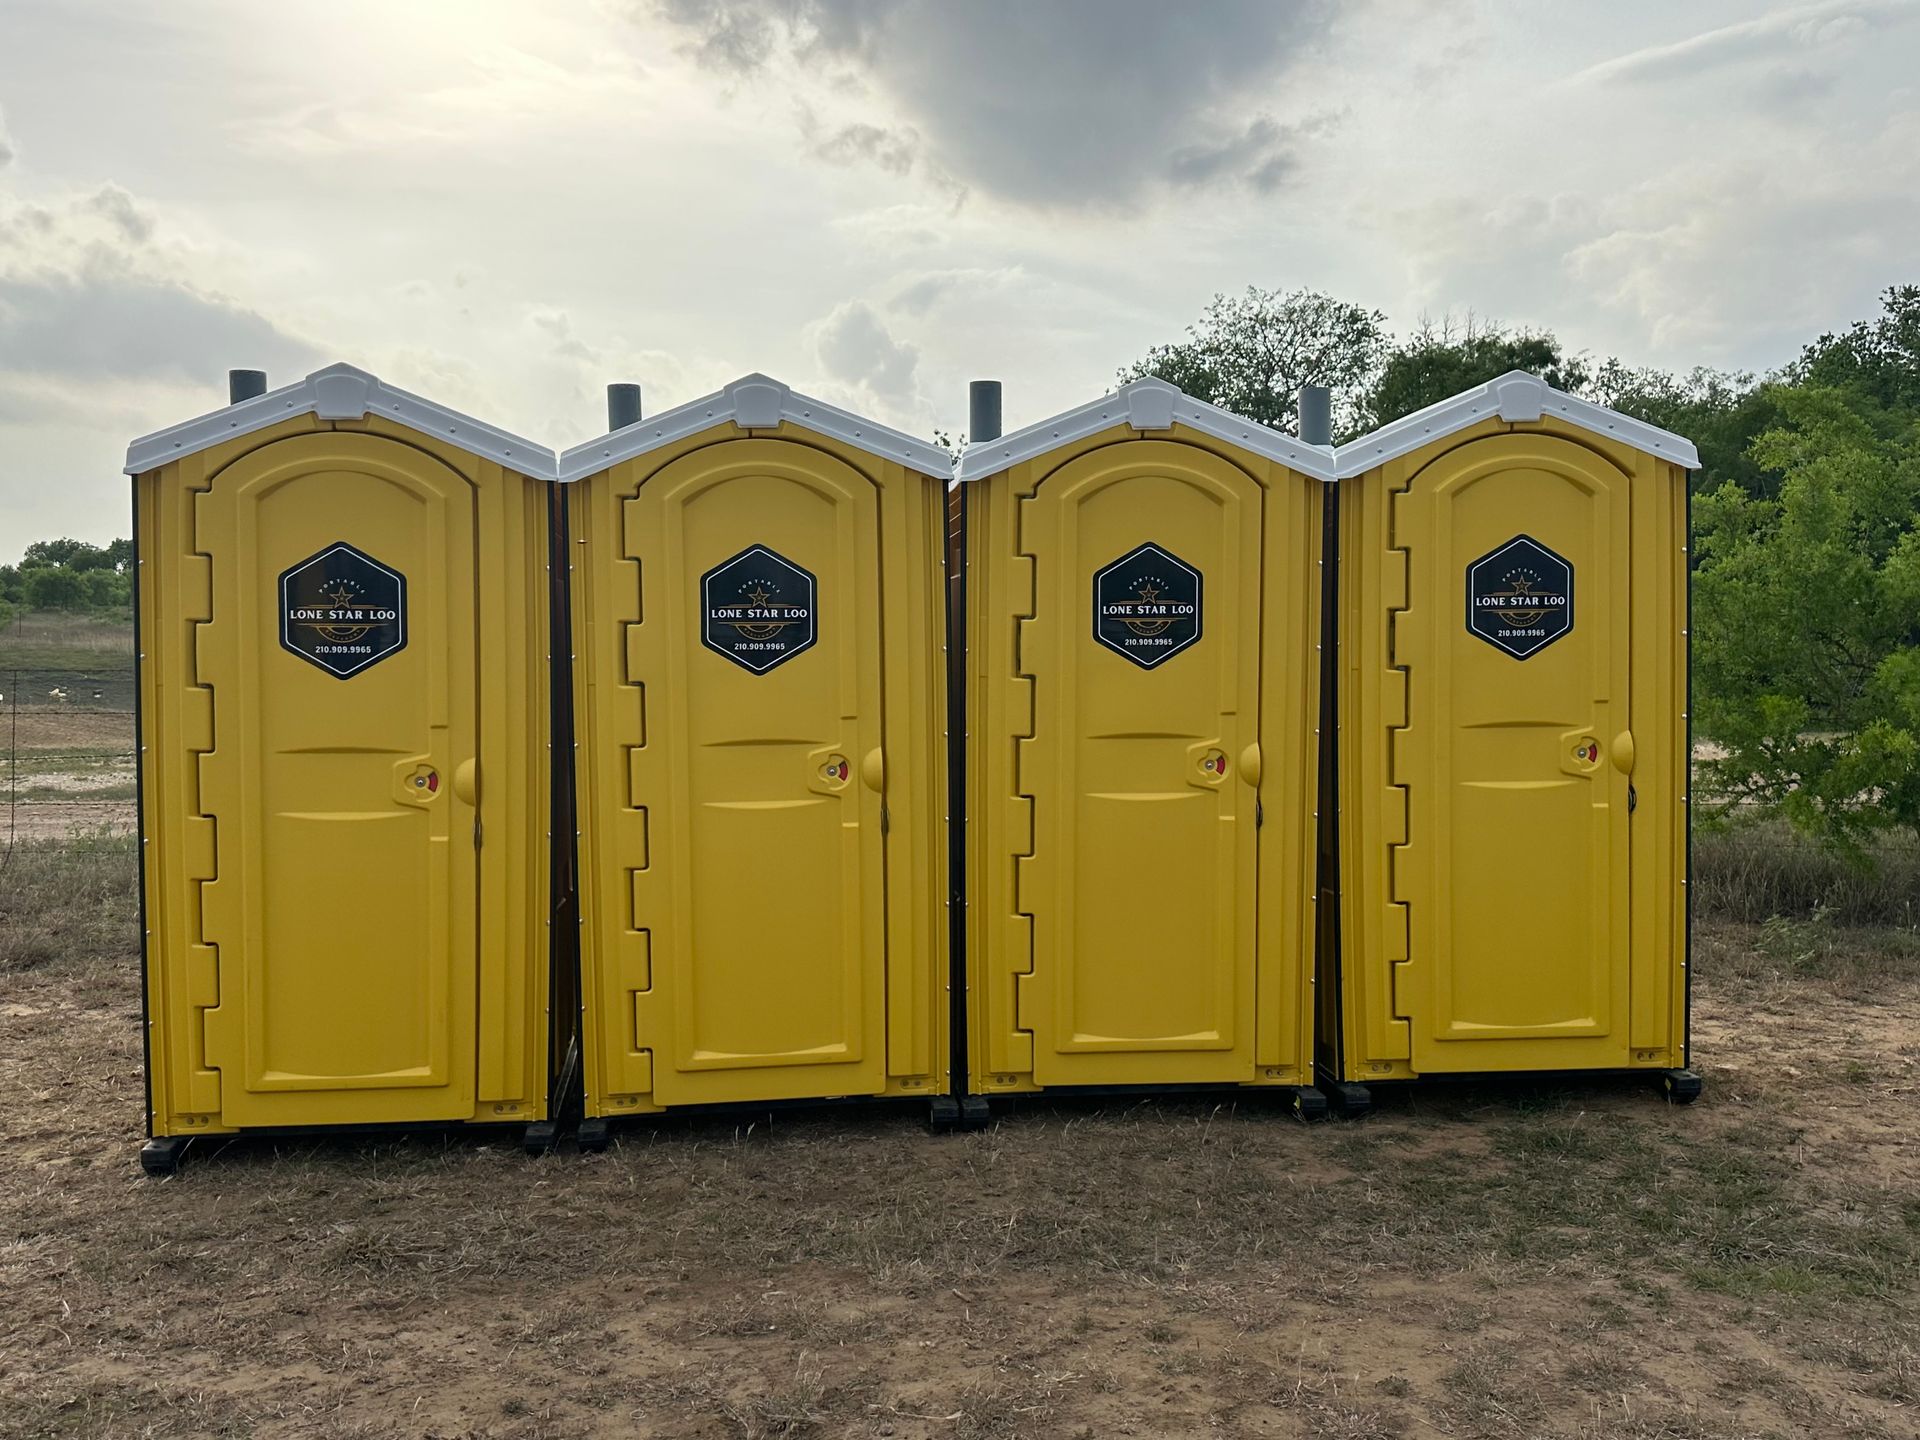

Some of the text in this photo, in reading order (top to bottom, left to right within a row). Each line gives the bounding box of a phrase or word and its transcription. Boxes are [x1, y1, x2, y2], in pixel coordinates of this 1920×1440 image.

[1476, 596, 1566, 606] LONE STAR LOO
[711, 609, 808, 618] LONE STAR LOO
[1103, 605, 1194, 614] LONE STAR LOO
[290, 610, 396, 620] LONE STAR LOO
[1498, 629, 1545, 637] 210.909.9965
[1124, 638, 1173, 646] 210.909.9965
[315, 646, 372, 654] 210.909.9965
